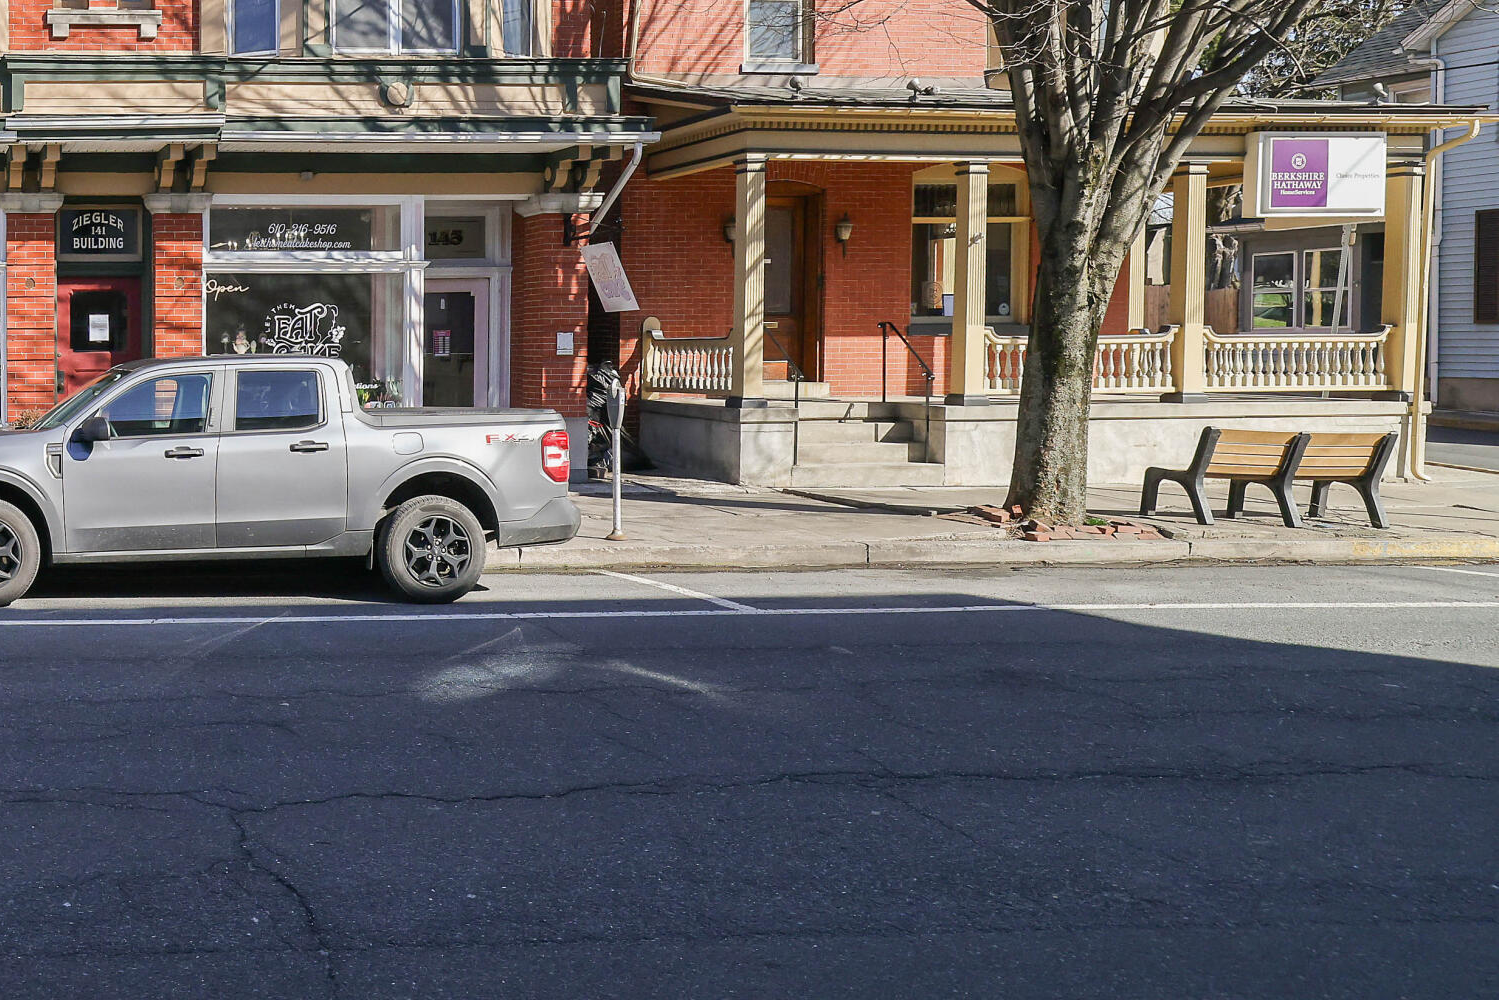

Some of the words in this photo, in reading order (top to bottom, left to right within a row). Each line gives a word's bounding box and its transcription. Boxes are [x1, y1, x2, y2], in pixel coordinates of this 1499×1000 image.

[1271, 172, 1325, 181] BERKSHIRE
[1273, 181, 1323, 189] HATHAWAY
[72, 212, 124, 232] ZIEGLER
[91, 226, 106, 235] 141
[268, 223, 337, 235] 610-216-9516
[73, 237, 124, 249] BUILDING
[205, 280, 250, 301] Open
[264, 315, 272, 333] LET
[270, 302, 296, 314] THEM
[273, 302, 328, 342] EAT
